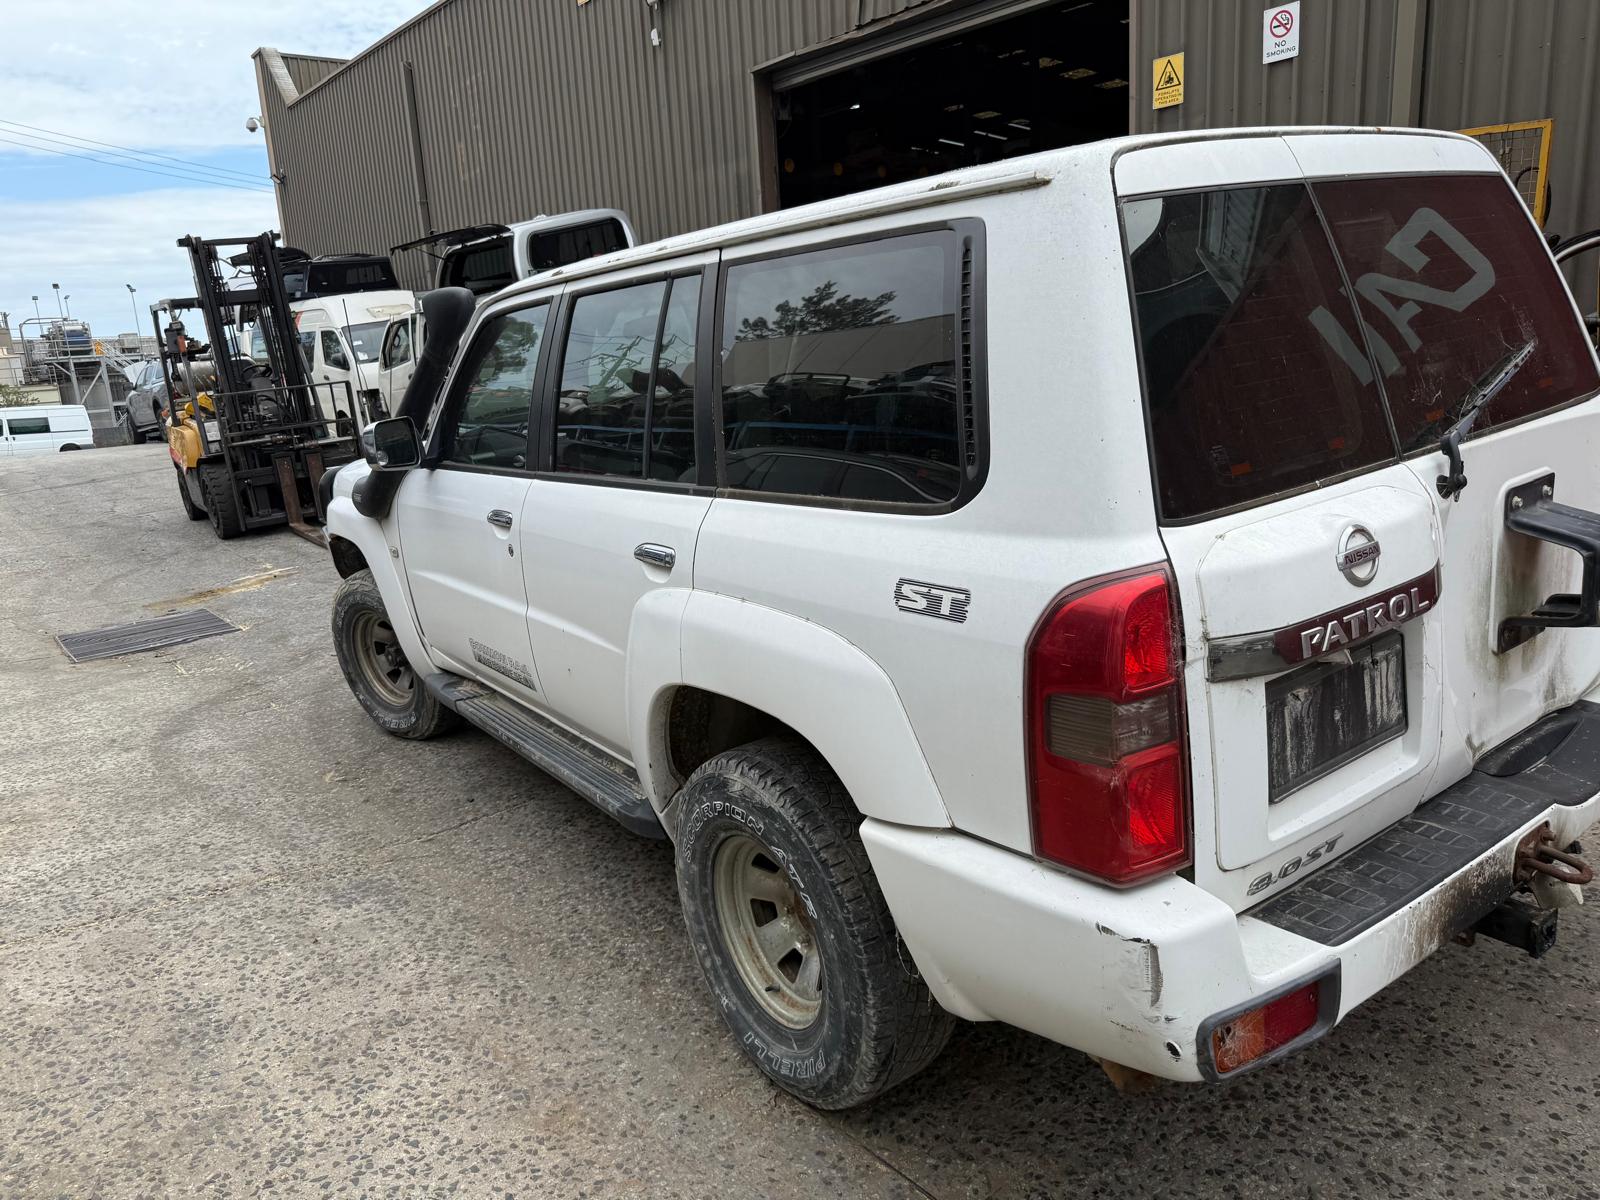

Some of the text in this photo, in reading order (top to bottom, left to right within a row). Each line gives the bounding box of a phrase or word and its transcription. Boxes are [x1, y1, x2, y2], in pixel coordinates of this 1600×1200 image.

[1266, 46, 1296, 58] SMOKING
[1274, 40, 1286, 48] NO
[1344, 545, 1379, 565] NISSAN
[895, 579, 970, 622] ST
[1301, 587, 1429, 660] PATROL
[682, 801, 765, 863] SCORPION
[743, 1031, 826, 1078] PIRELLI
